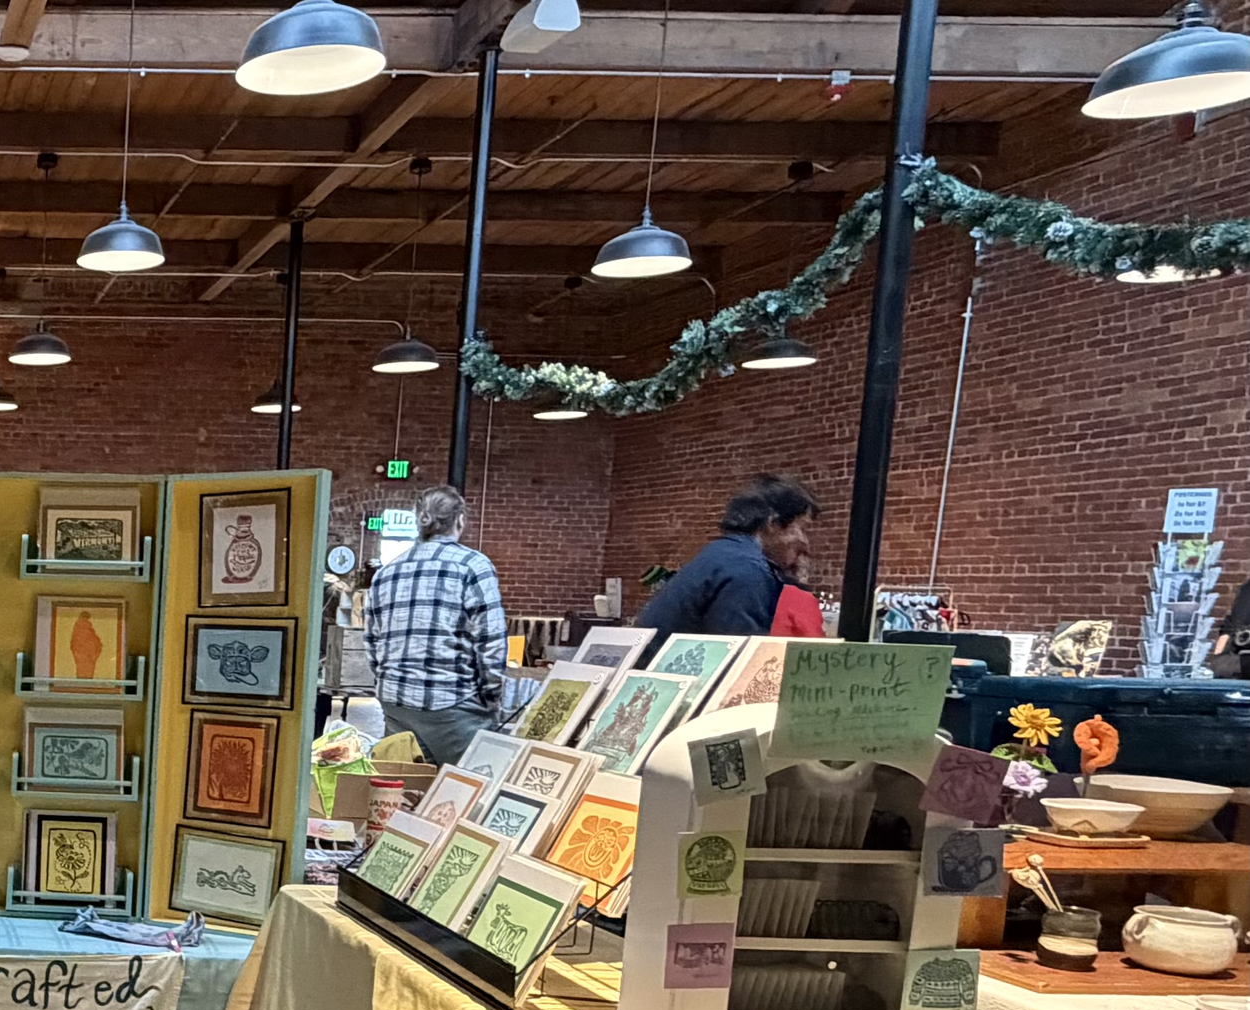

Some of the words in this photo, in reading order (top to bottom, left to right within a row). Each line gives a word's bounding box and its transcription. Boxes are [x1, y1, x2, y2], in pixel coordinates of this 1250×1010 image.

[387, 460, 409, 478] EXIT
[790, 649, 906, 684] Mystery
[369, 799, 399, 809] JAPAN
